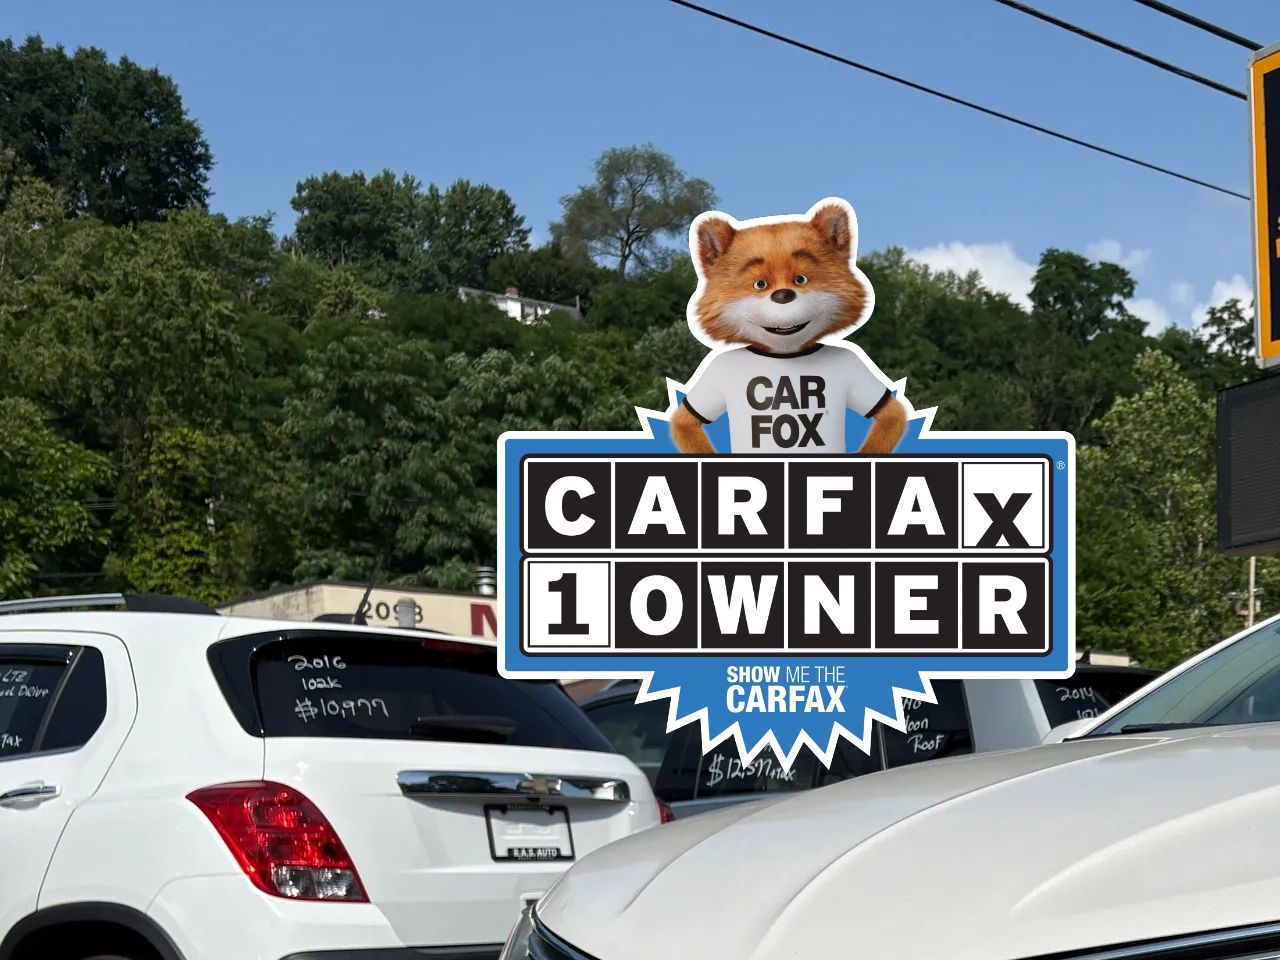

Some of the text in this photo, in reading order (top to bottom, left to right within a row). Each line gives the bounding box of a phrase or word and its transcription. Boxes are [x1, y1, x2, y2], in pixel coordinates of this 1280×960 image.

[287, 654, 347, 671] 2016
[1056, 687, 1097, 703] 2014
[905, 715, 929, 732] oon
